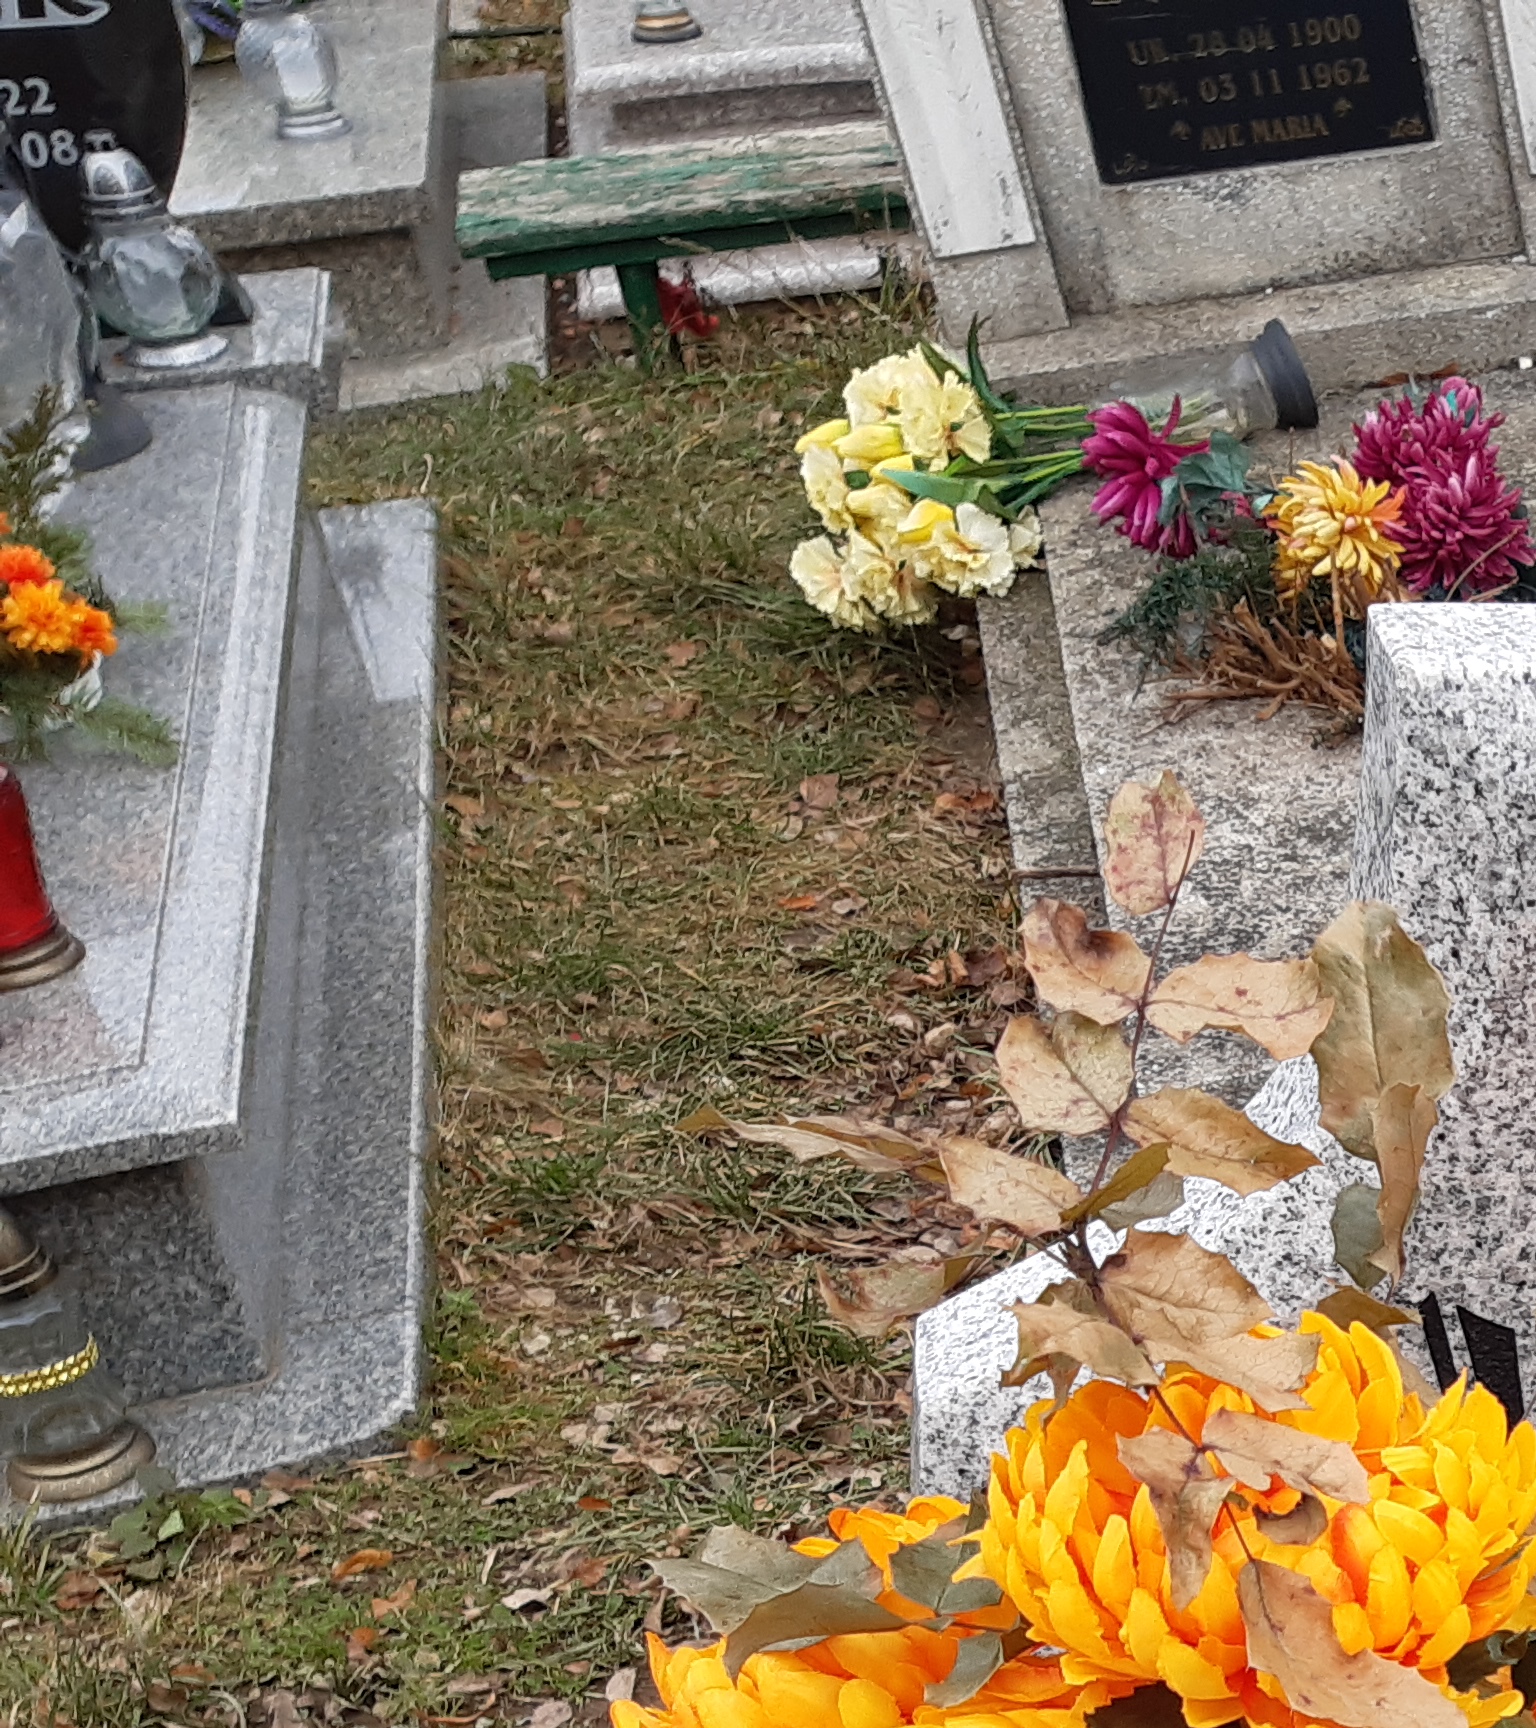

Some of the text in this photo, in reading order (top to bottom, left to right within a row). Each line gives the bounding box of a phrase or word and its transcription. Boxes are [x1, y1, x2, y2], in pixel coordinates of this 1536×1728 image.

[1288, 14, 1361, 48] 1900
[1200, 74, 1238, 104] 03
[1250, 68, 1283, 97] 11
[1299, 57, 1370, 91] 1962
[1250, 113, 1329, 143] MARIA
